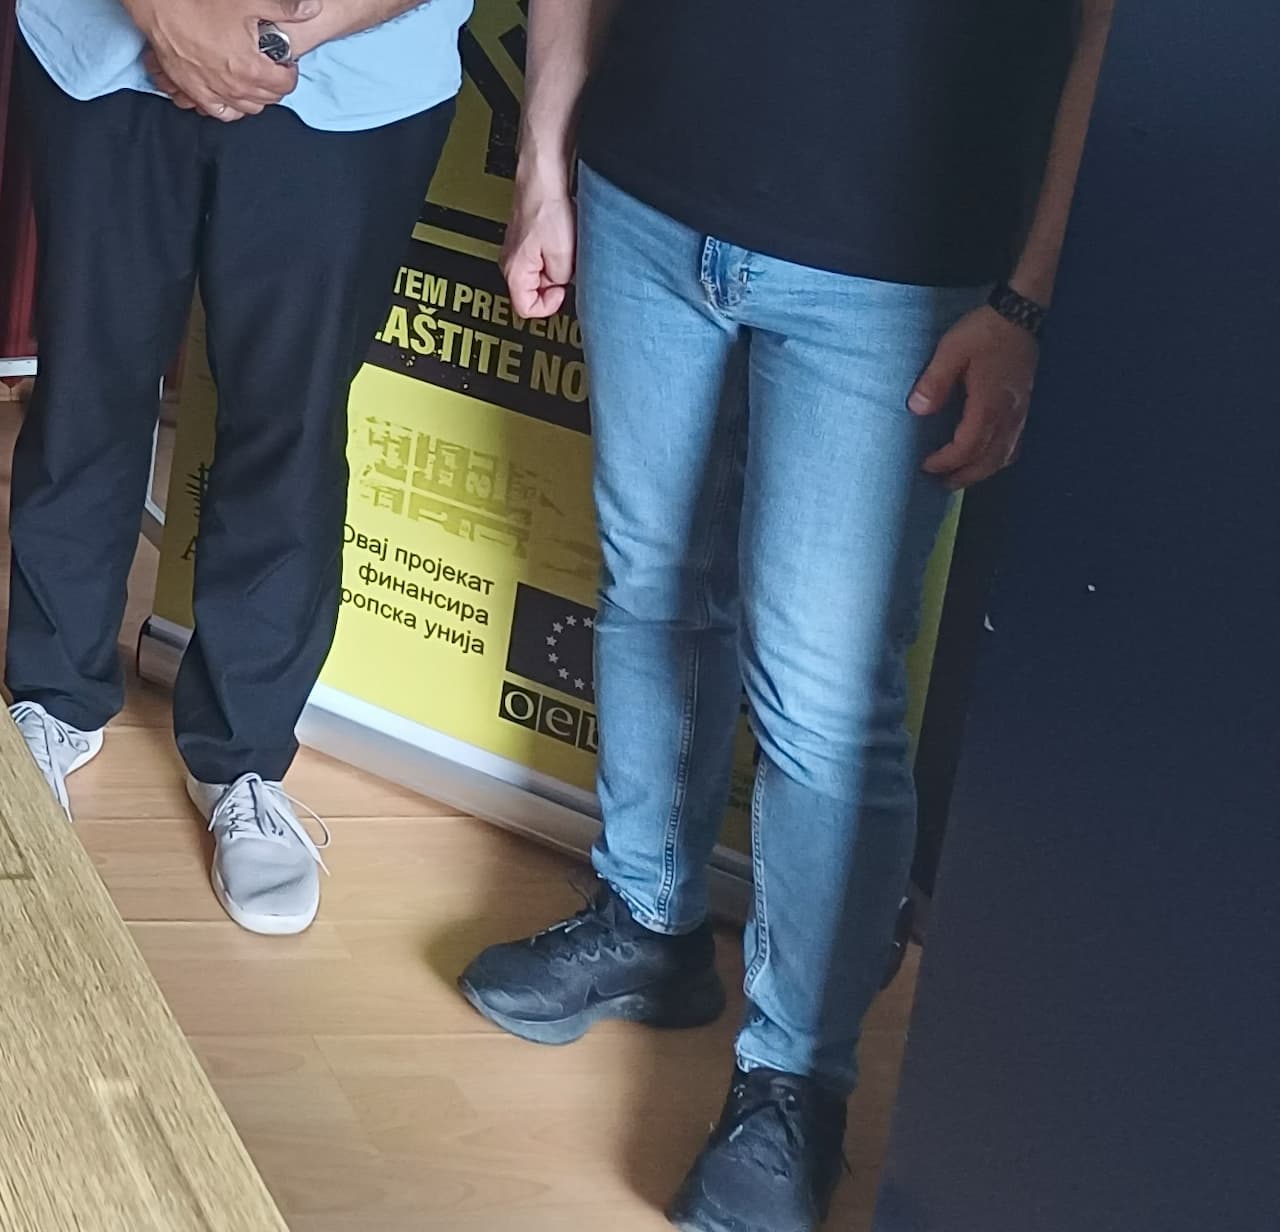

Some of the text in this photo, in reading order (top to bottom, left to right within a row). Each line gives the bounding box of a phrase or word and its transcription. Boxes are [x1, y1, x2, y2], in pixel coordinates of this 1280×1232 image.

[374, 303, 524, 384] AŠTITE
[343, 523, 495, 596] Овај пројекат
[358, 562, 490, 626] финансира
[423, 617, 485, 656] унија
